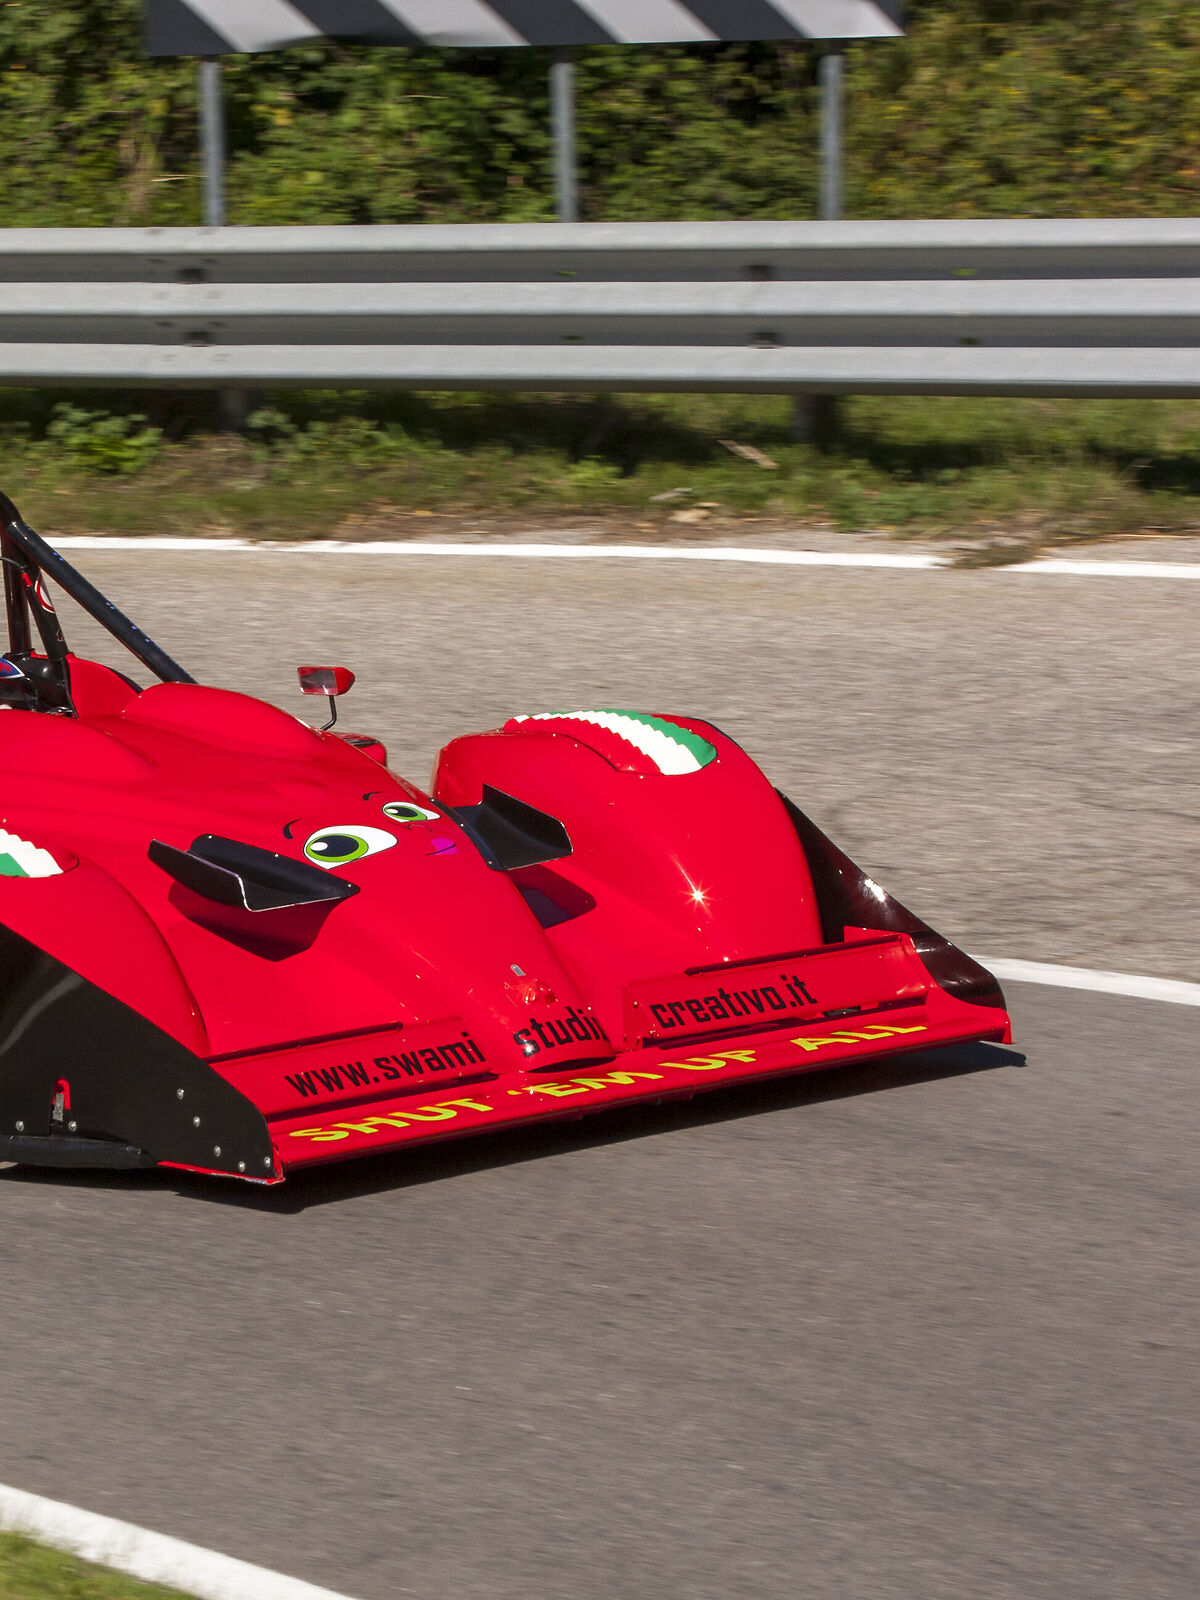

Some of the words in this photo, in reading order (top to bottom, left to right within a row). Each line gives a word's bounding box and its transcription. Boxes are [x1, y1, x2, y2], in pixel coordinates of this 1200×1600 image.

[284, 1031, 486, 1098] www.swami
[650, 973, 818, 1030] creativo.it
[288, 1096, 494, 1143] SHUT
[658, 1049, 758, 1070] UP
[790, 1023, 928, 1051] ALL
